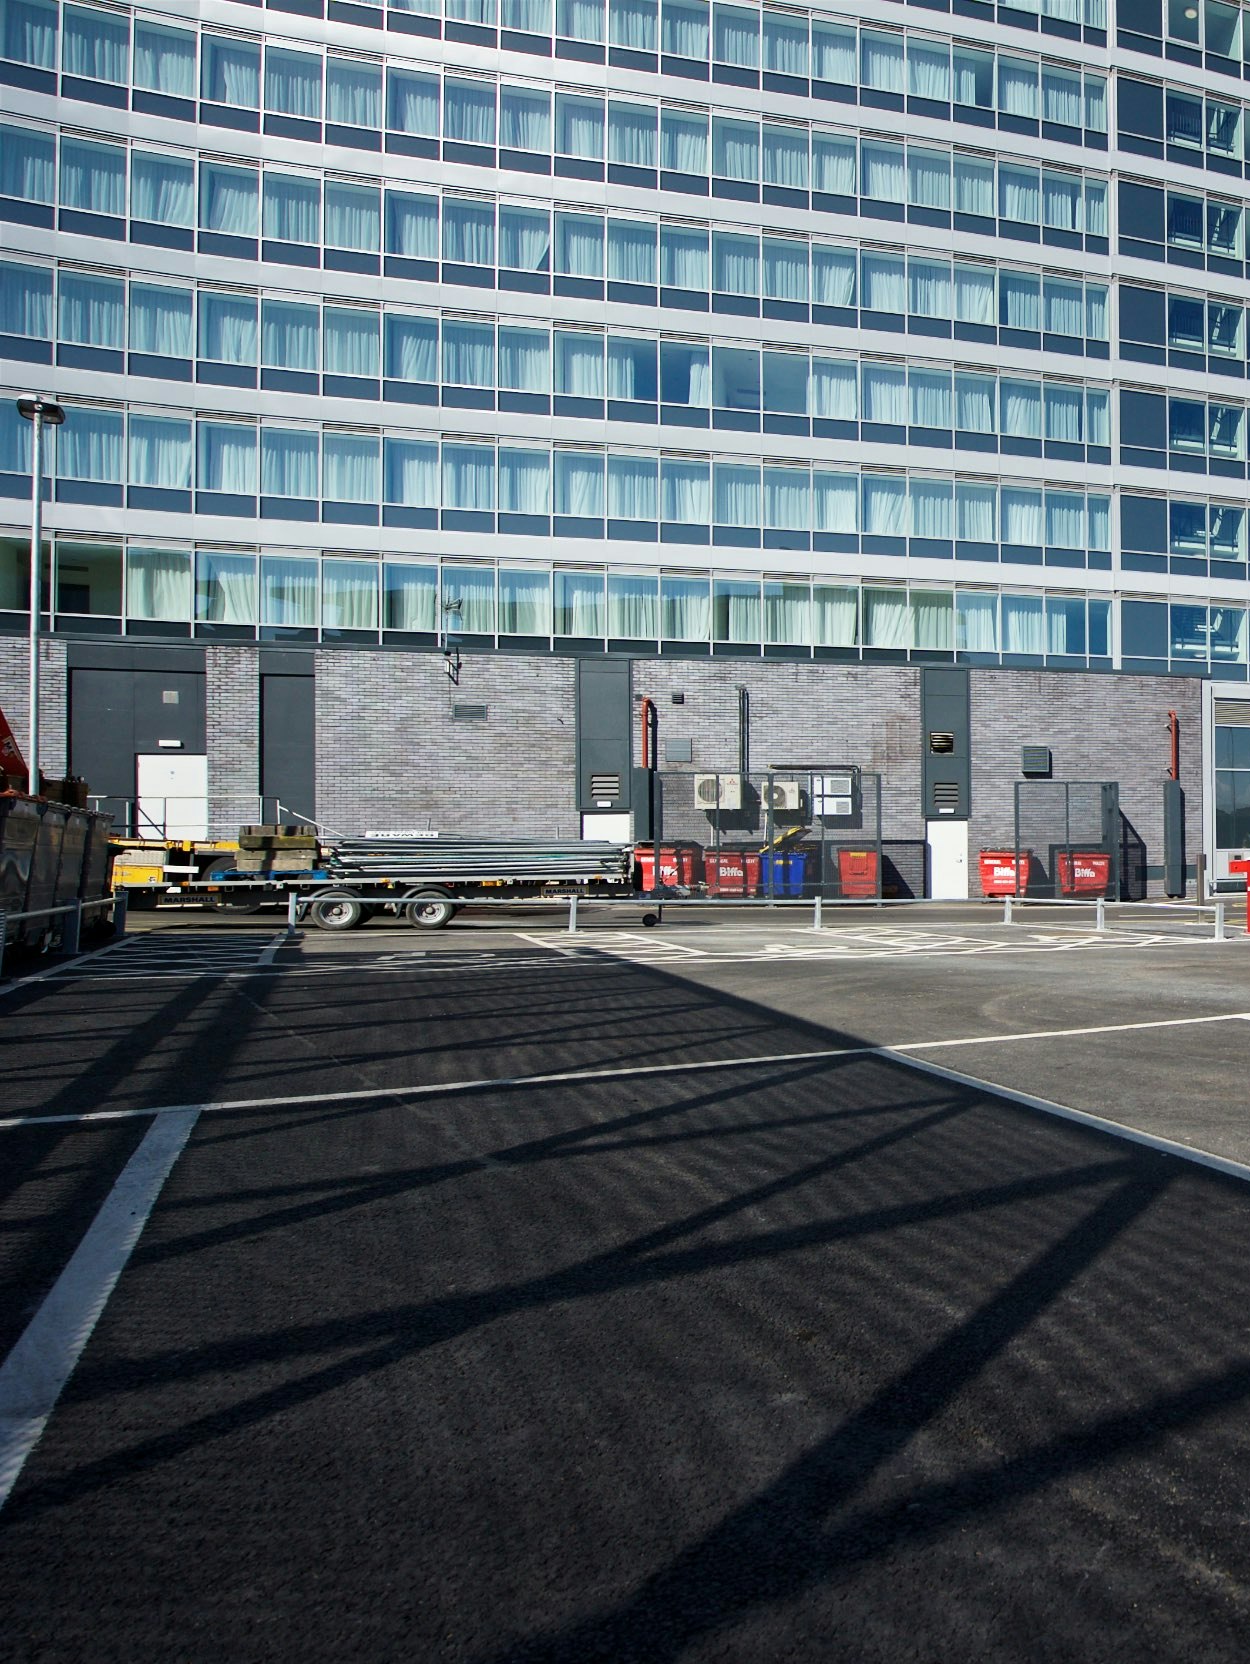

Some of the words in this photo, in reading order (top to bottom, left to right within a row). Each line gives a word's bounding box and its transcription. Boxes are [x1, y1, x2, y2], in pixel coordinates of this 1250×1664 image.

[719, 866, 744, 877] Biffa
[993, 866, 1016, 877] Biffa
[1074, 867, 1096, 878] Biffa
[545, 887, 585, 895] MARSHALL
